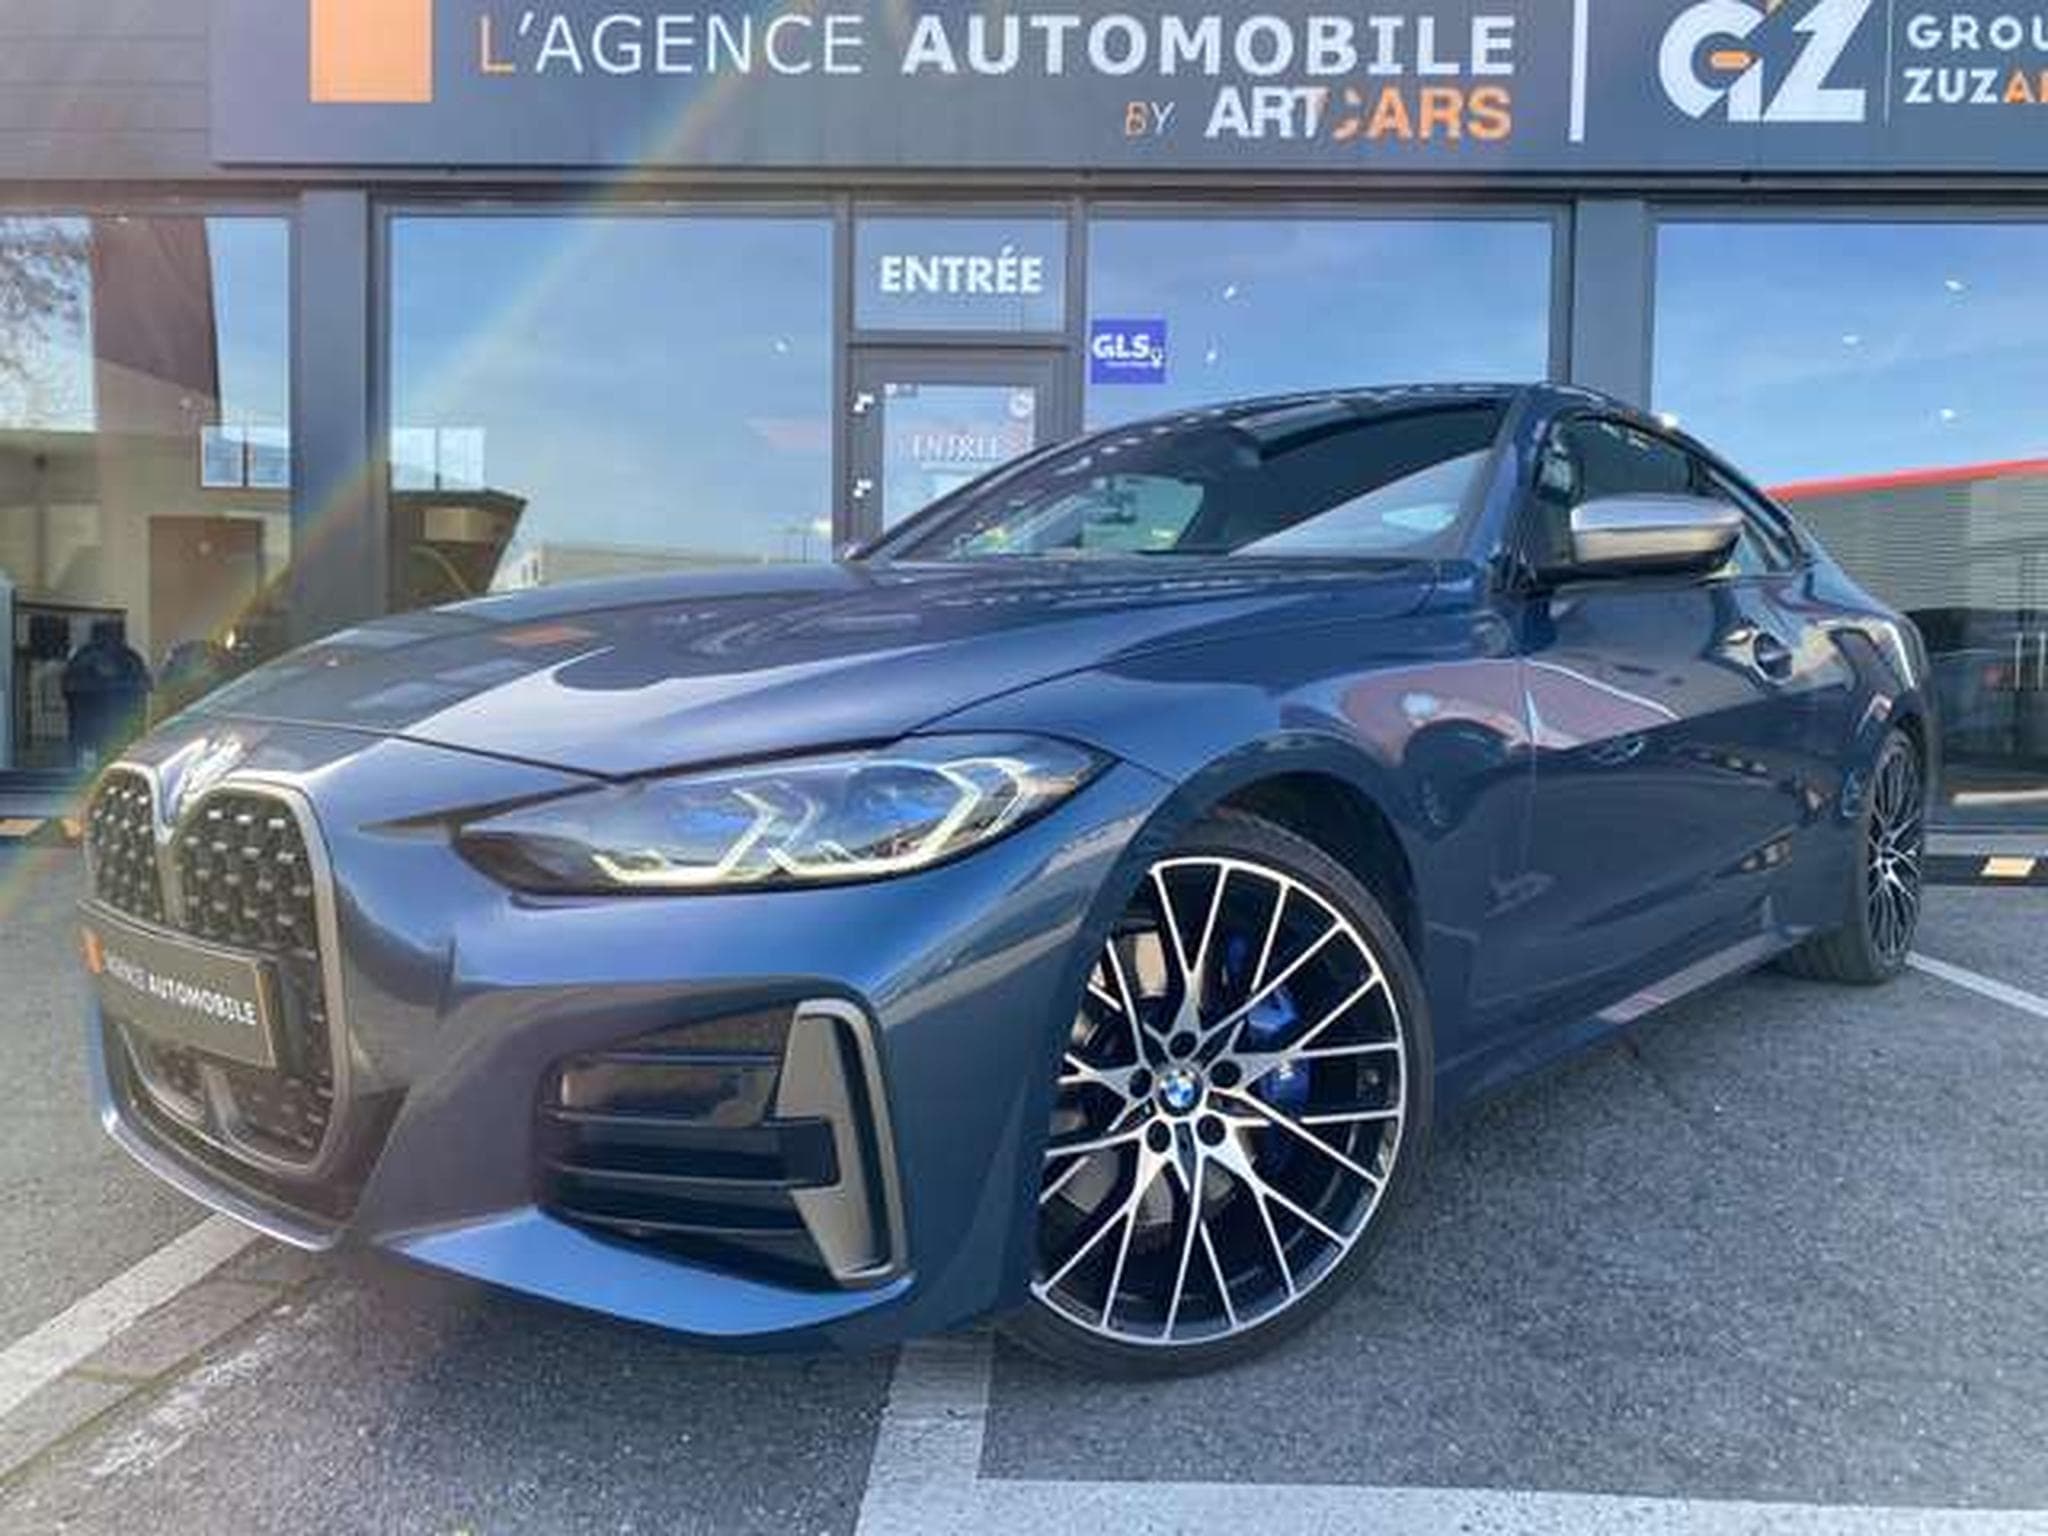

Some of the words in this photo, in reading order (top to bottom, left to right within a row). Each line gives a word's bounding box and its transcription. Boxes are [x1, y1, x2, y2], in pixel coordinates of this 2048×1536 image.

[480, 13, 865, 75] L'AGENCE
[901, 14, 1516, 75] AUTOMOBILE
[1125, 102, 1175, 136] BY
[1204, 86, 1512, 139] ARTCARS
[879, 244, 1044, 293] ENTRÉE
[1093, 333, 1151, 358] GLS
[149, 972, 257, 1026] AUTOMOBILE
